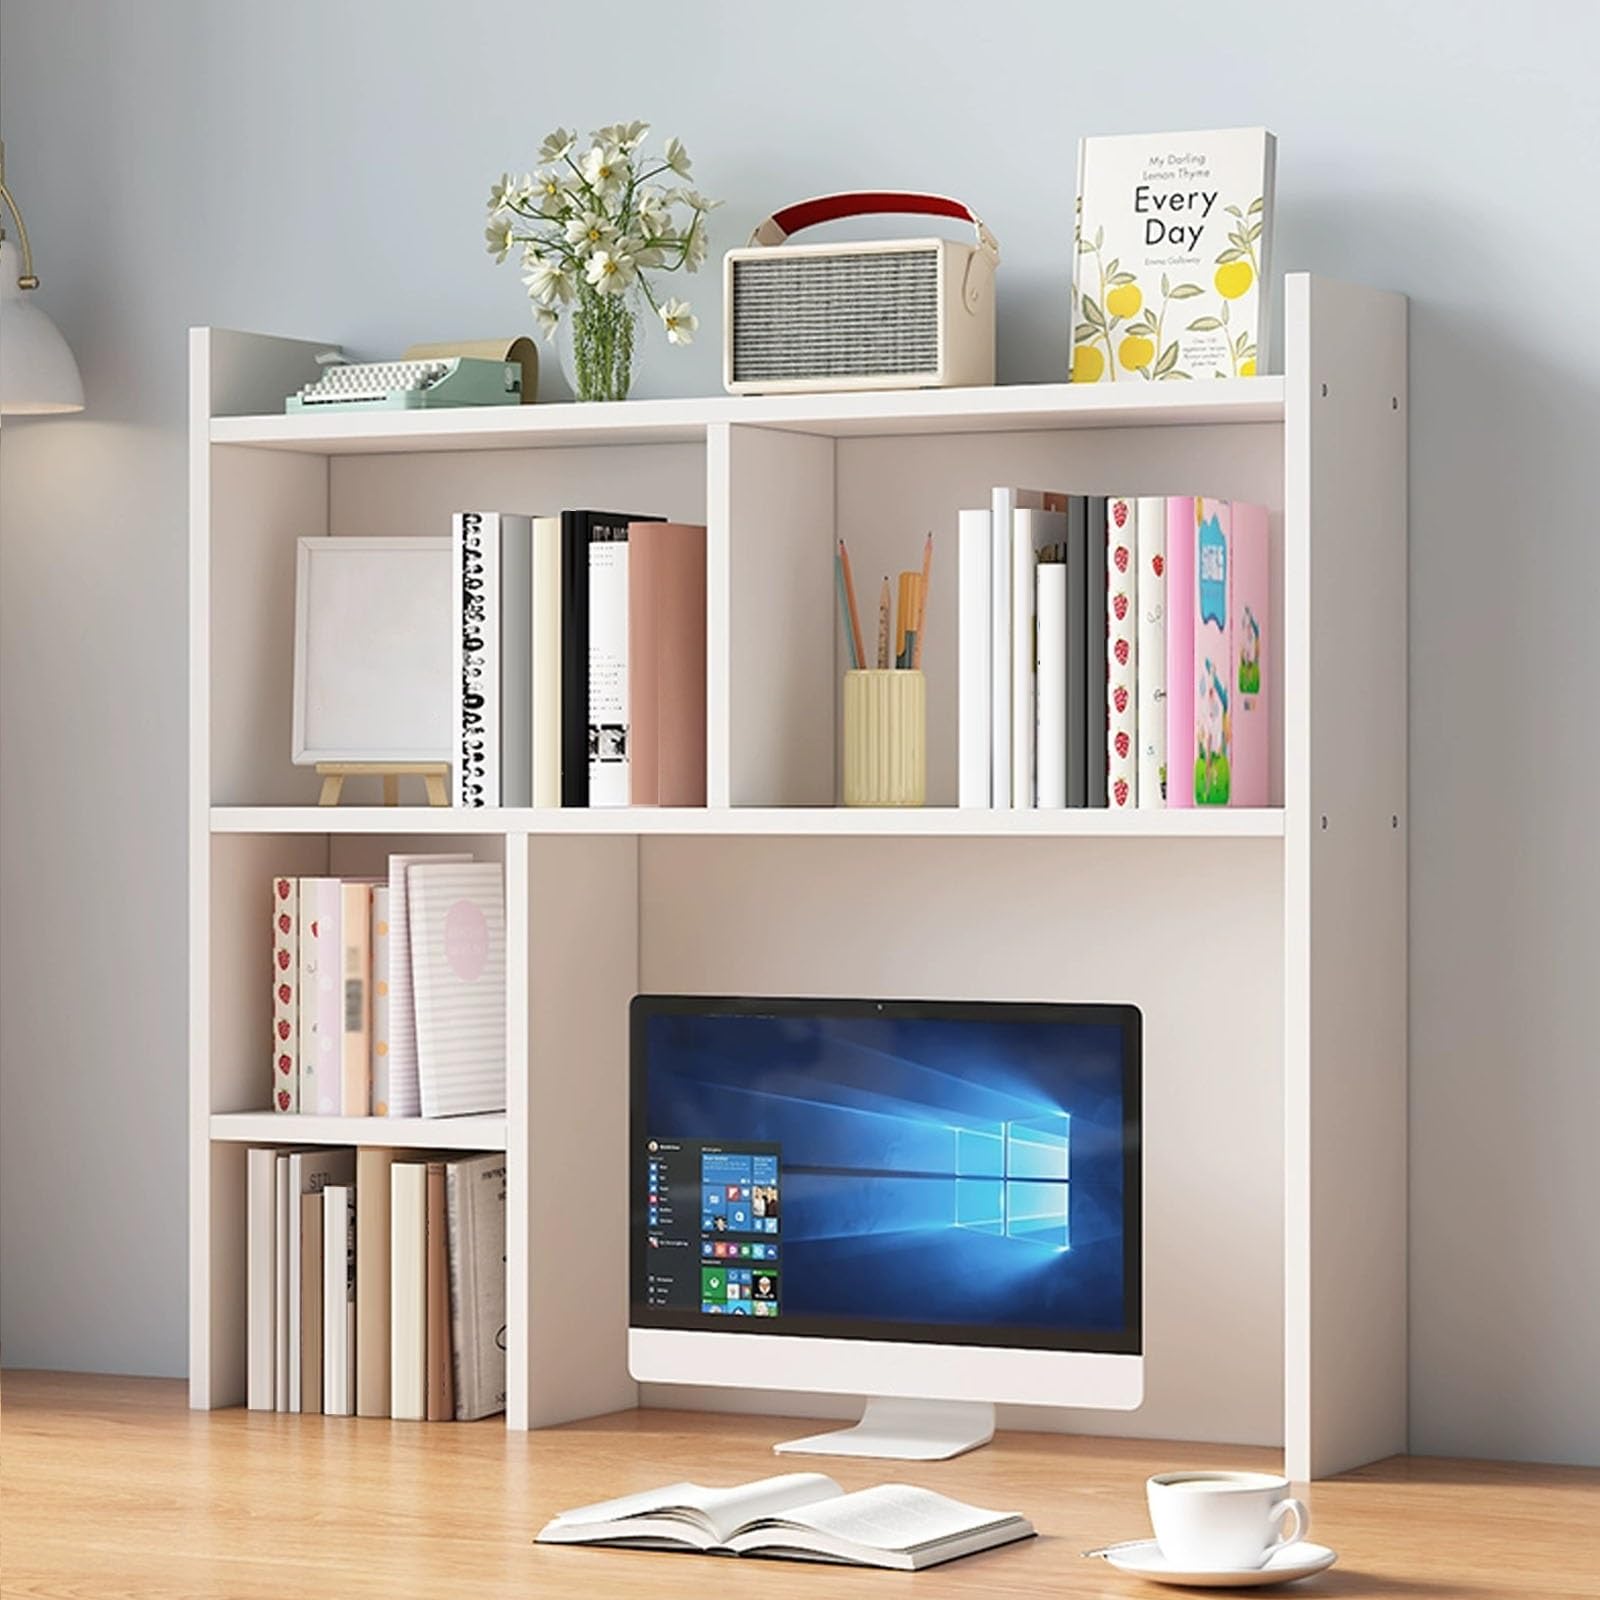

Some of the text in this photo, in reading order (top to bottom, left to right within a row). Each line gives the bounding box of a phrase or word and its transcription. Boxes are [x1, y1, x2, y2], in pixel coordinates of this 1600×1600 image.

[1148, 156, 1164, 168] My
[1135, 185, 1218, 218] Every
[1145, 218, 1205, 252] Day
